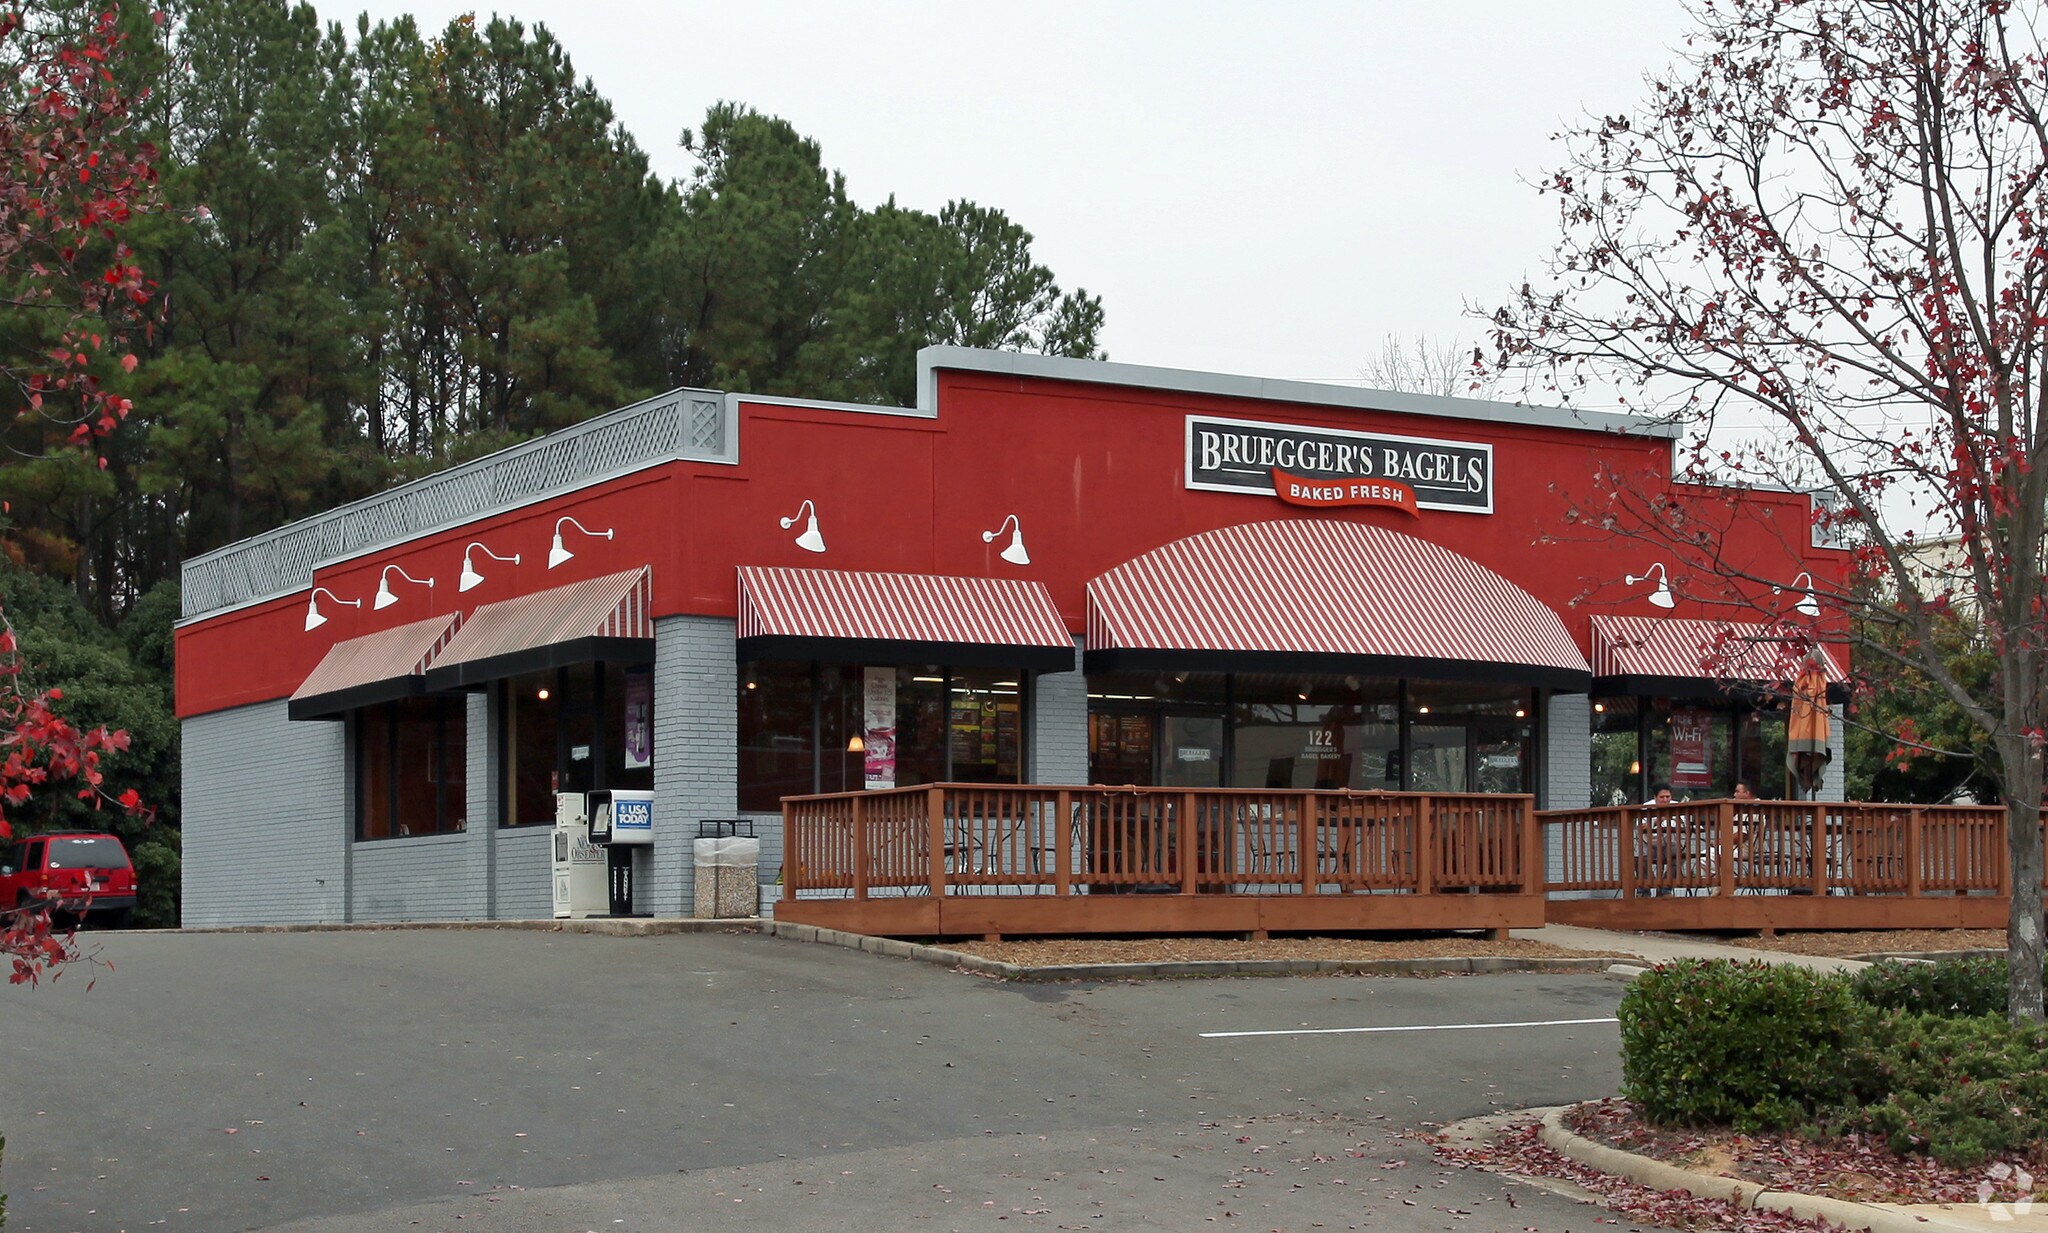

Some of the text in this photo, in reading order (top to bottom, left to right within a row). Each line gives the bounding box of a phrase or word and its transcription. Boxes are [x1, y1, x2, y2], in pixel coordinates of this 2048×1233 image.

[1199, 431, 1484, 494] BRUEGGER'S BAGELS
[1290, 483, 1404, 503] BAKED FRESH
[1309, 730, 1333, 746] 122
[1673, 725, 1702, 742] Wi-Fi
[628, 804, 648, 814] USA
[618, 813, 649, 824] TODAY
